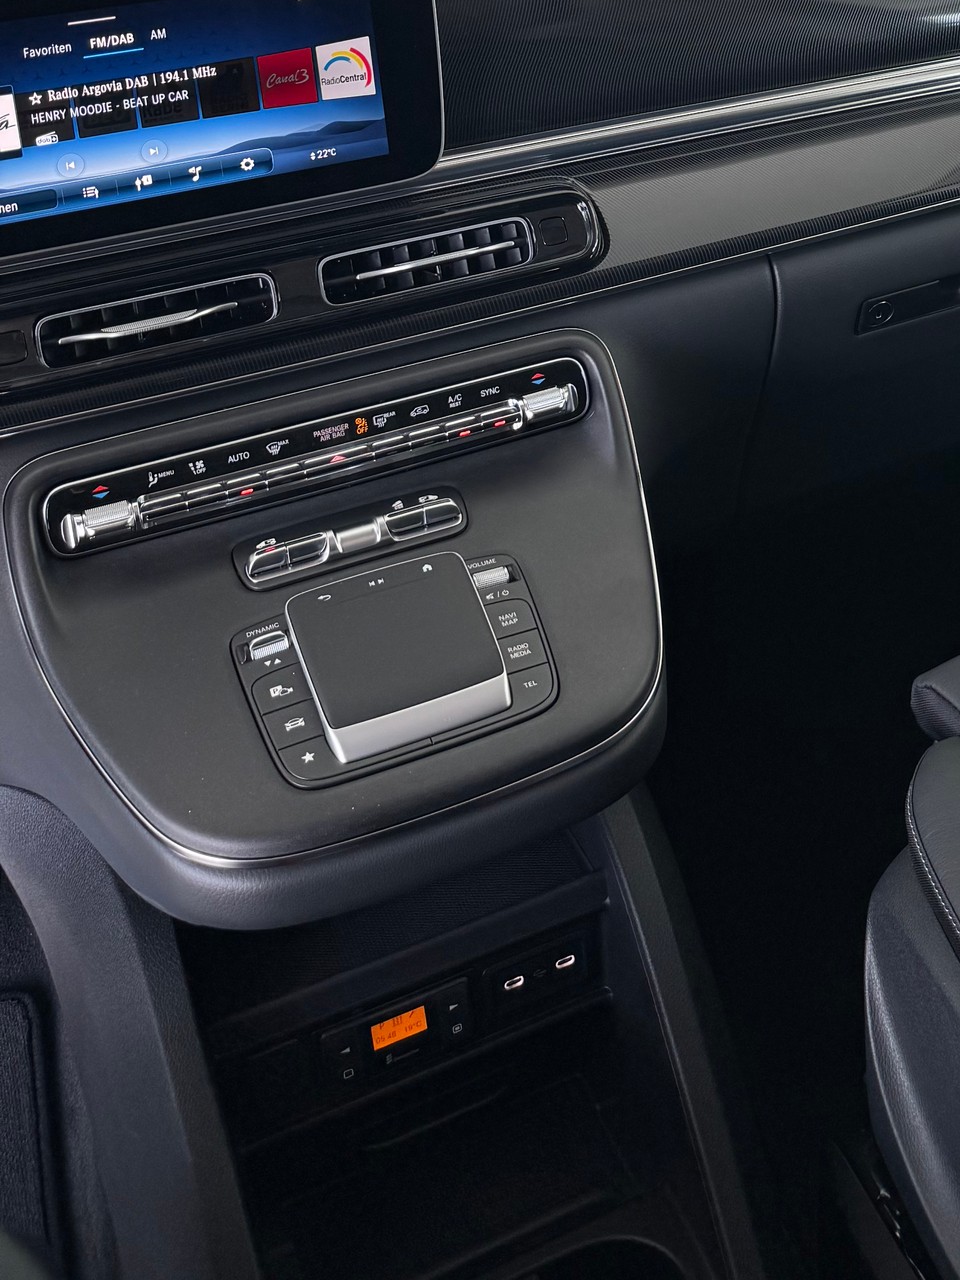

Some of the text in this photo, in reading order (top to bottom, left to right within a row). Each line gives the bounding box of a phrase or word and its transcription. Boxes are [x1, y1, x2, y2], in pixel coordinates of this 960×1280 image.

[23, 28, 167, 59] Favoriten FM/DAB AM
[47, 87, 79, 102] Radio
[82, 80, 123, 97] Argovia
[125, 75, 149, 90] DAB
[159, 70, 189, 84] 194.1
[192, 65, 217, 80] MHz
[31, 108, 67, 125] HENRY
[70, 101, 113, 119] MOODIE
[123, 96, 149, 110] BEAT
[151, 93, 166, 105] UP
[168, 89, 190, 102] CAR
[480, 386, 500, 398] SYNC
[448, 393, 462, 404] A/C
[313, 423, 350, 438] PASSENGER
[320, 430, 346, 442] AIR BAG
[356, 426, 368, 435] OFF
[277, 439, 290, 447] MAX
[228, 451, 250, 464] AUTO
[158, 470, 175, 479] MENU
[467, 558, 497, 570] VOLUME
[498, 612, 517, 622] NAVI
[501, 618, 519, 627] MAP
[246, 622, 280, 638] DYNAMIC
[507, 643, 529, 653] RADIO
[510, 649, 532, 660] MEDIA
[523, 680, 538, 689] TEL
